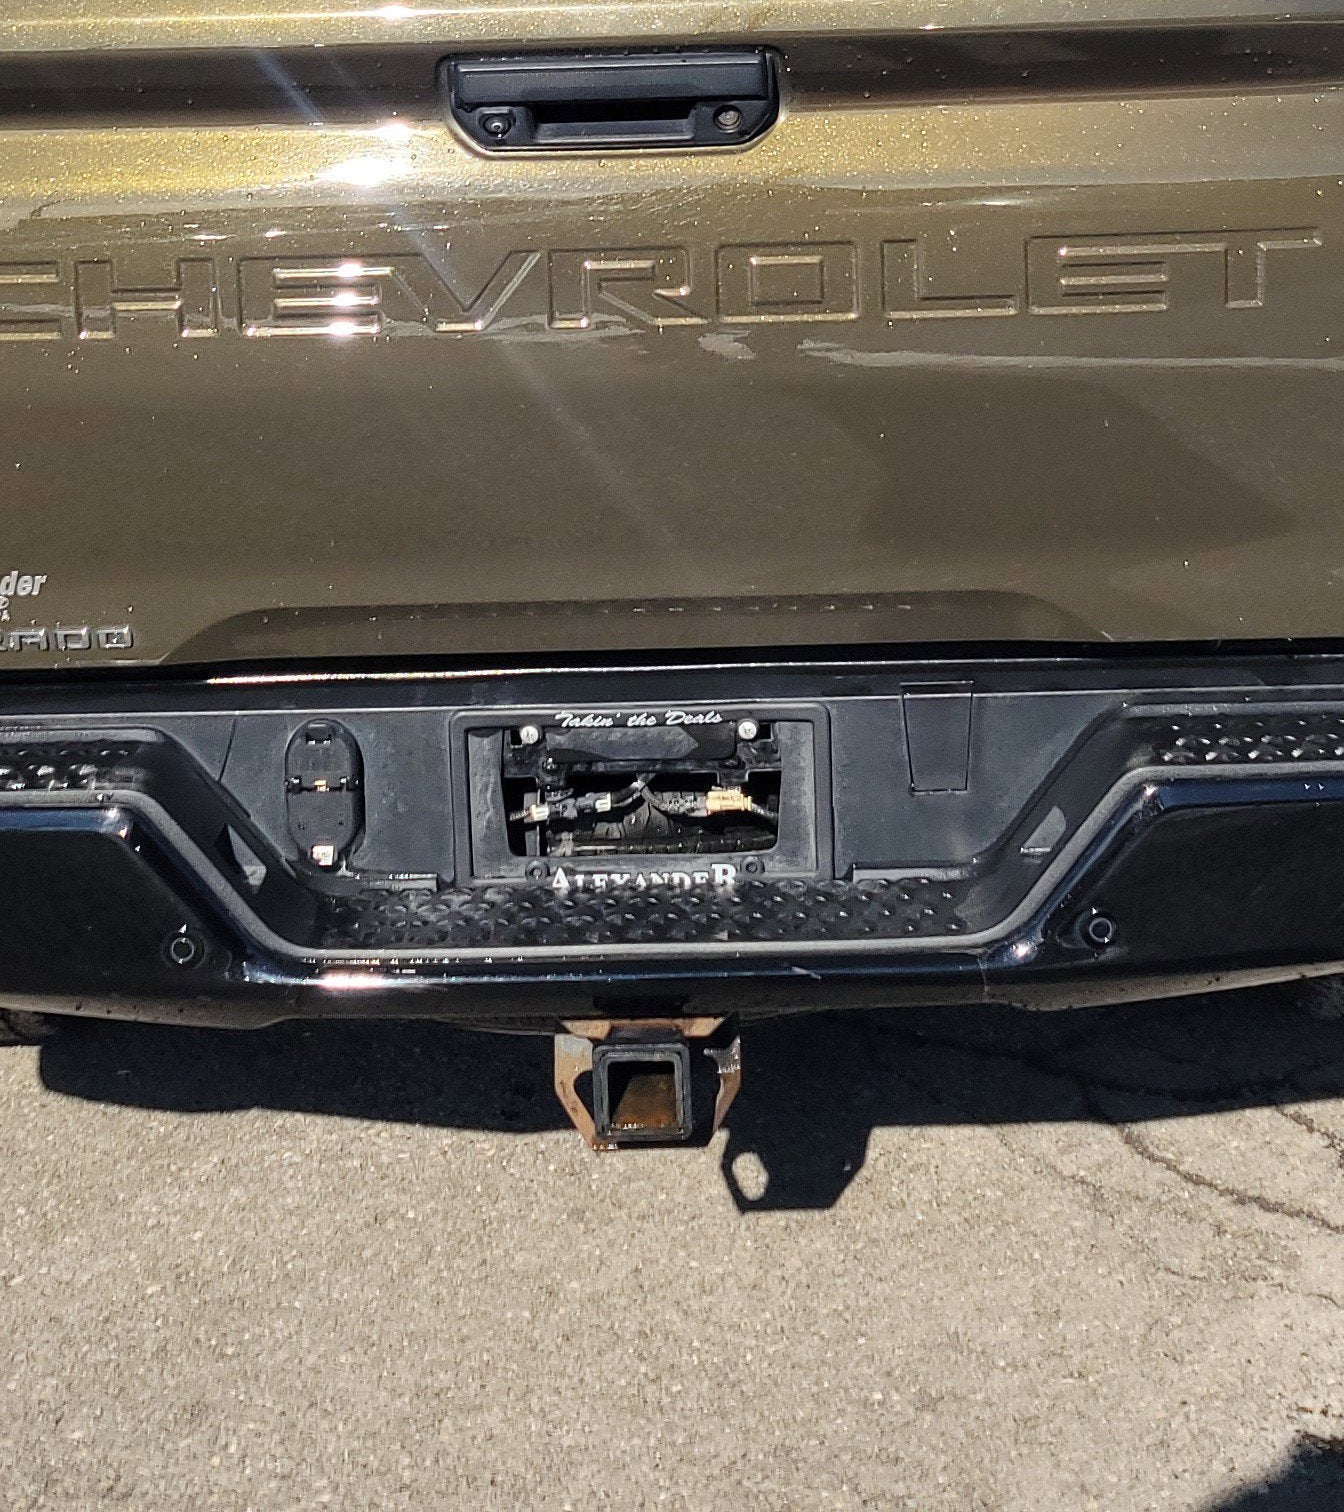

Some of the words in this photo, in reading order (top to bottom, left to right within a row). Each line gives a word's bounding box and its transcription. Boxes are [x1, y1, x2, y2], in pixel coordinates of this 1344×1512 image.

[555, 710, 622, 727] Takin'
[627, 711, 657, 727] the
[664, 709, 724, 726] Deals
